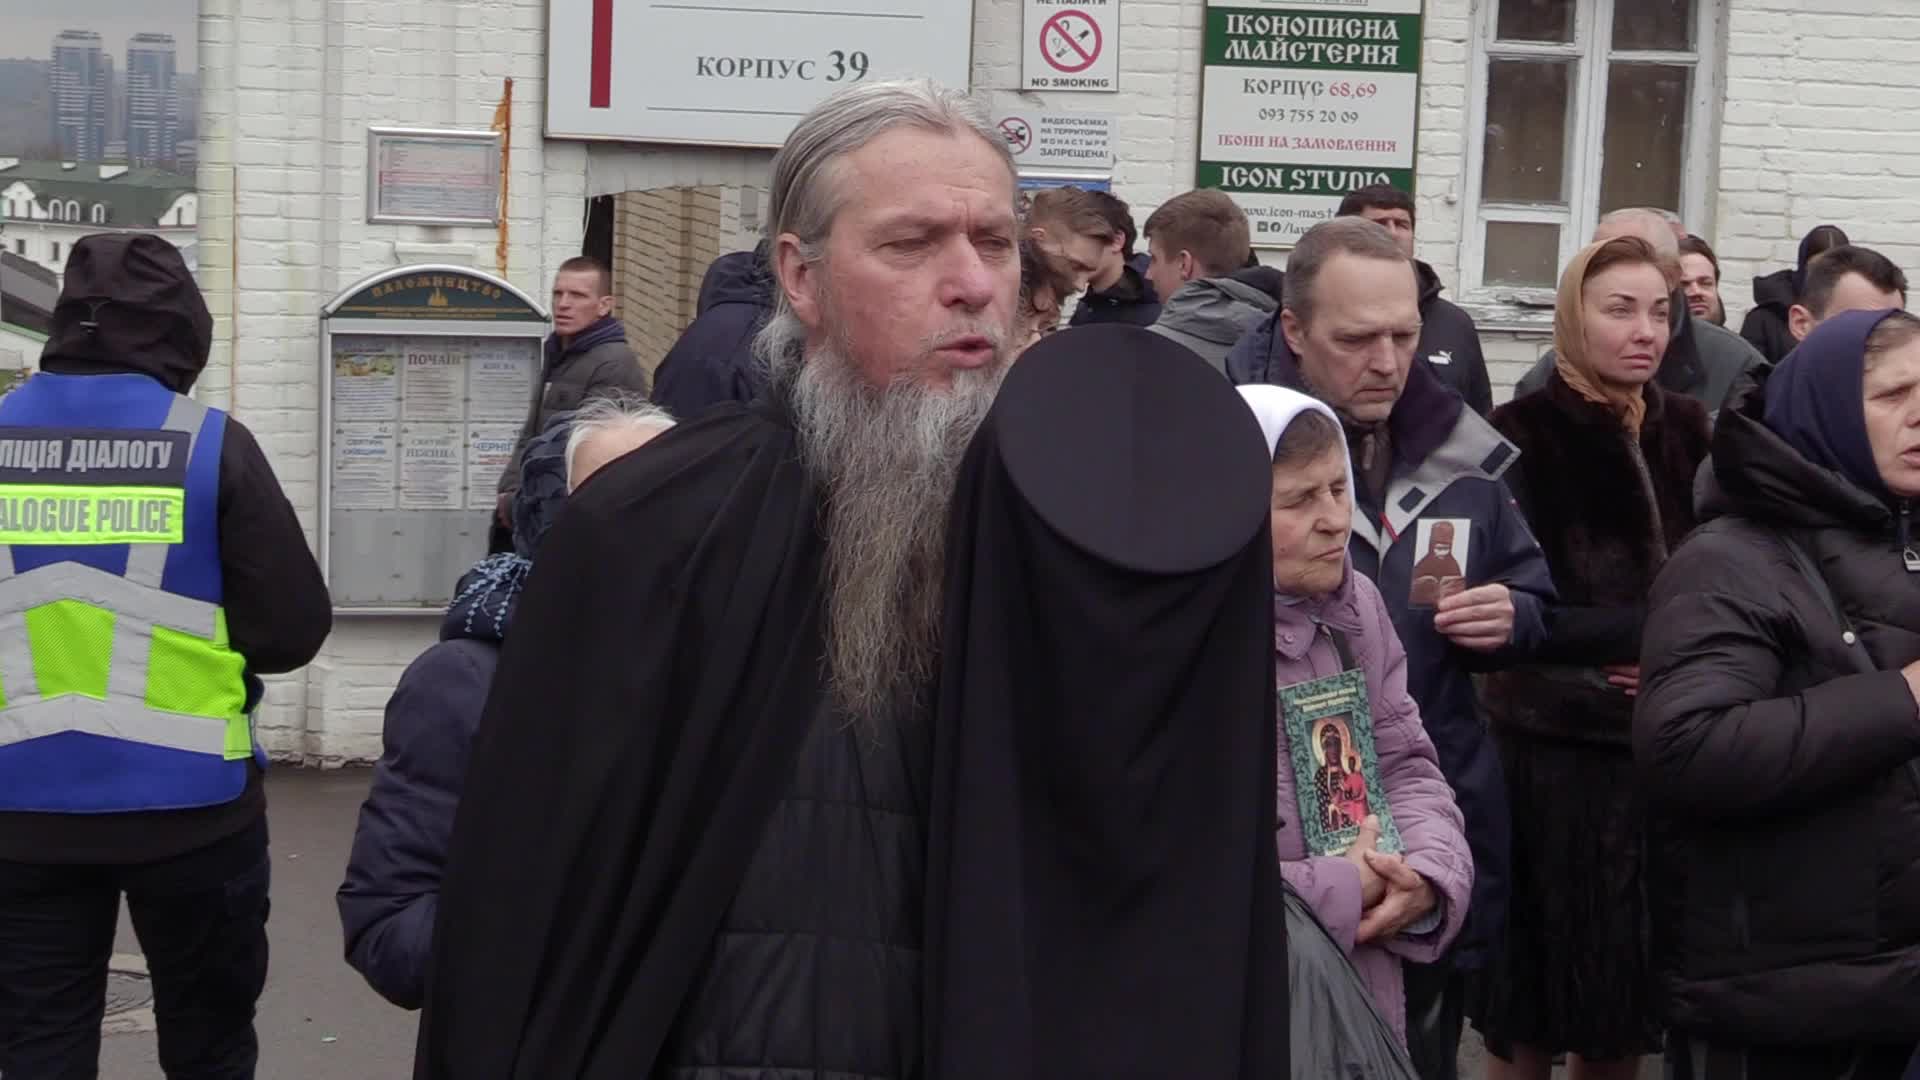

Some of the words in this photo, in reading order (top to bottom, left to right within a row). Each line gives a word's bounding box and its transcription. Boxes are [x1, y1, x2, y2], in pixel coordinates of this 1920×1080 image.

[1225, 14, 1400, 40] ІКОНОПИСНА
[1224, 37, 1400, 65] МАЙСТЕРНЯ
[695, 56, 817, 81] КОРПУС
[825, 49, 870, 82] 39
[1031, 77, 1049, 87] NO
[1052, 78, 1109, 88] SMOKING
[1243, 78, 1324, 100] КОРПУС
[1329, 82, 1377, 99] 68,69
[1258, 108, 1285, 122] 093
[1290, 109, 1315, 122] 755
[1319, 110, 1337, 123] 20
[1341, 111, 1359, 124] 09
[1217, 134, 1265, 147] ІКОНИ
[1268, 135, 1289, 148] НА
[1291, 136, 1397, 152] ЗАМОВЛЕННЯ
[1221, 166, 1284, 188] ICON
[65, 439, 173, 473] ДІАЛОГУ
[95, 498, 173, 534] POLICE
